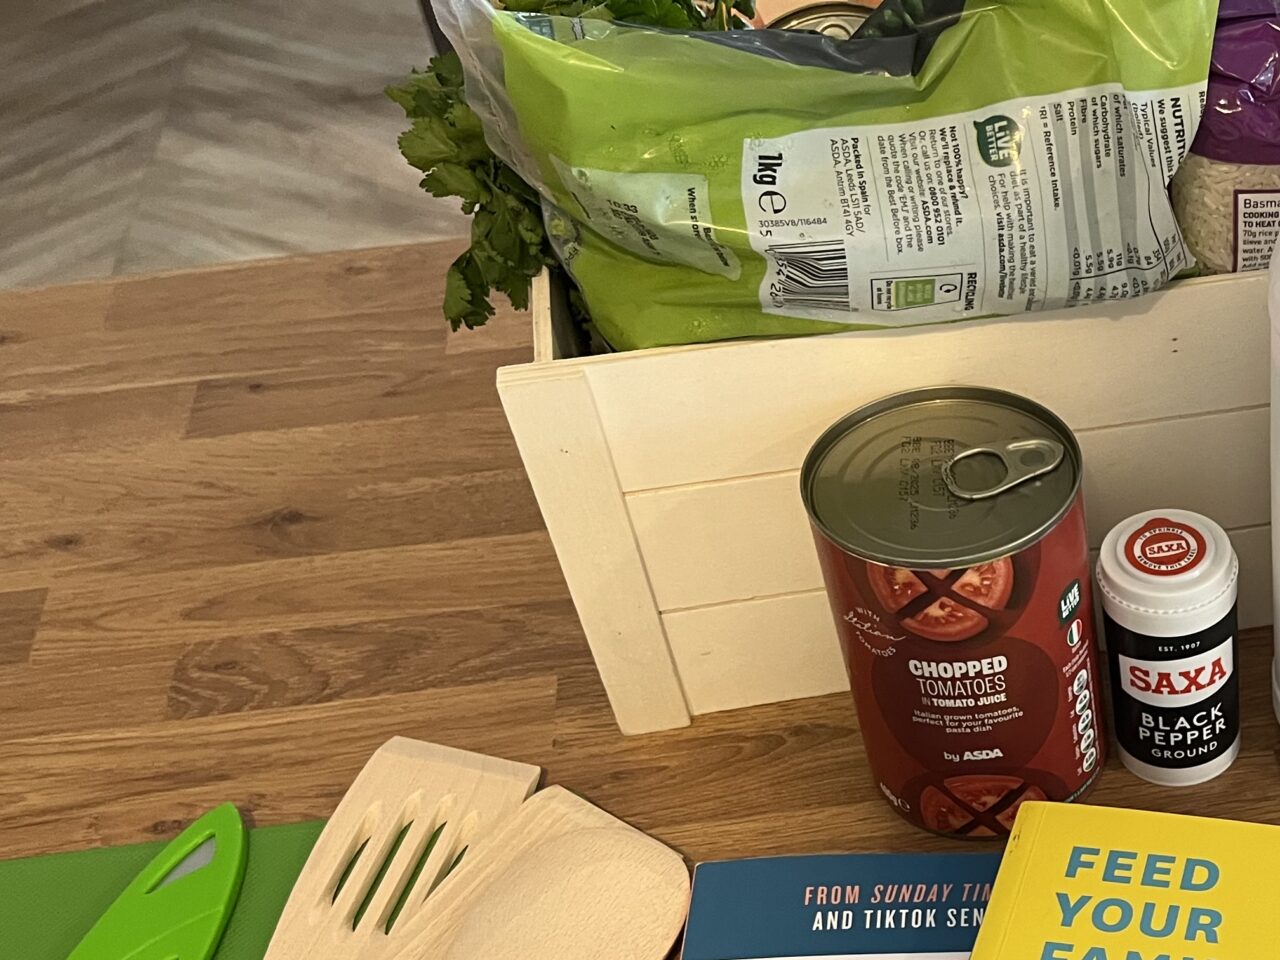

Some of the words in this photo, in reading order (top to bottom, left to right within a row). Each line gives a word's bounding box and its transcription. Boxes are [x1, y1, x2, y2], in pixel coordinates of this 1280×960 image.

[1053, 102, 1063, 122] Salt
[1080, 98, 1088, 123] Fibre
[1156, 98, 1166, 115] We
[1067, 100, 1077, 135] Protein
[1091, 108, 1099, 136] which
[1099, 94, 1112, 157] Carbohydrate
[1114, 106, 1122, 133] which
[928, 129, 939, 157] Return
[949, 125, 958, 142] Not
[985, 125, 998, 161] BETTER
[1139, 102, 1152, 136] Typical
[1146, 138, 1156, 167] Values
[1158, 116, 1171, 153] suggest
[850, 136, 863, 169] Packed
[877, 135, 887, 155] date
[887, 134, 897, 159] quote
[921, 144, 930, 159] call
[952, 143, 962, 167] 100%
[1093, 138, 1101, 168] sugars
[881, 156, 890, 174] from
[923, 161, 930, 170] us
[934, 159, 941, 168] to
[1116, 135, 1126, 177] saturates
[1165, 155, 1174, 172] this
[753, 152, 783, 187] 1kg
[892, 161, 900, 173] the
[941, 151, 954, 183] replace
[1043, 130, 1057, 177] Reference
[1051, 179, 1061, 210] Intake.
[845, 168, 856, 191] Leeds
[884, 176, 893, 188] the
[894, 175, 904, 192] code
[935, 170, 943, 185] one
[955, 167, 968, 199] happy?
[997, 172, 1007, 188] For
[857, 179, 869, 203] Spain
[887, 189, 896, 205] Best
[898, 133, 909, 158] When
[913, 224, 925, 252] please
[911, 152, 919, 166] our
[920, 199, 934, 244] ASDA.com
[928, 186, 939, 206] 0800
[1001, 191, 1011, 210] help
[835, 170, 846, 196] Antrim
[843, 219, 854, 237] 4GY
[862, 204, 872, 216] for
[1015, 203, 1024, 221] part
[1021, 187, 1035, 231] important
[890, 208, 902, 235] Before
[902, 215, 911, 231] and
[933, 207, 942, 223] 952
[995, 211, 1005, 231] visit
[1004, 212, 1014, 231] with
[1243, 211, 1279, 219] COOKING
[905, 234, 914, 248] the
[935, 225, 945, 245] 0101
[1027, 233, 1035, 242] to
[1006, 233, 1014, 263] making
[1018, 241, 1028, 271] healthy
[1027, 244, 1036, 258] eat
[1148, 542, 1186, 555] SAXA
[1181, 641, 1201, 650] 1907
[908, 655, 1008, 678] CHOPPED
[1129, 657, 1227, 696] SAXA
[916, 675, 1006, 696] TOMATOES
[932, 698, 975, 707] TOMATO
[977, 693, 1007, 706] JUICE
[912, 716, 944, 726] perfect
[946, 719, 959, 727] for
[984, 711, 1024, 725] favourite
[914, 710, 941, 719] Italian
[1141, 702, 1223, 731] BLACK
[973, 725, 993, 733] dish
[1139, 718, 1226, 746] PEPPER
[943, 752, 960, 762] by
[963, 748, 1004, 761] ASDA
[1151, 741, 1218, 759] GROUND
[1065, 846, 1220, 892] FEED
[804, 885, 860, 906] FROM
[871, 883, 952, 904] SUNDAY
[812, 910, 853, 930] AND
[864, 908, 937, 930] TIKTOK
[947, 908, 985, 928] SEN
[1055, 892, 1223, 944] YOUR
